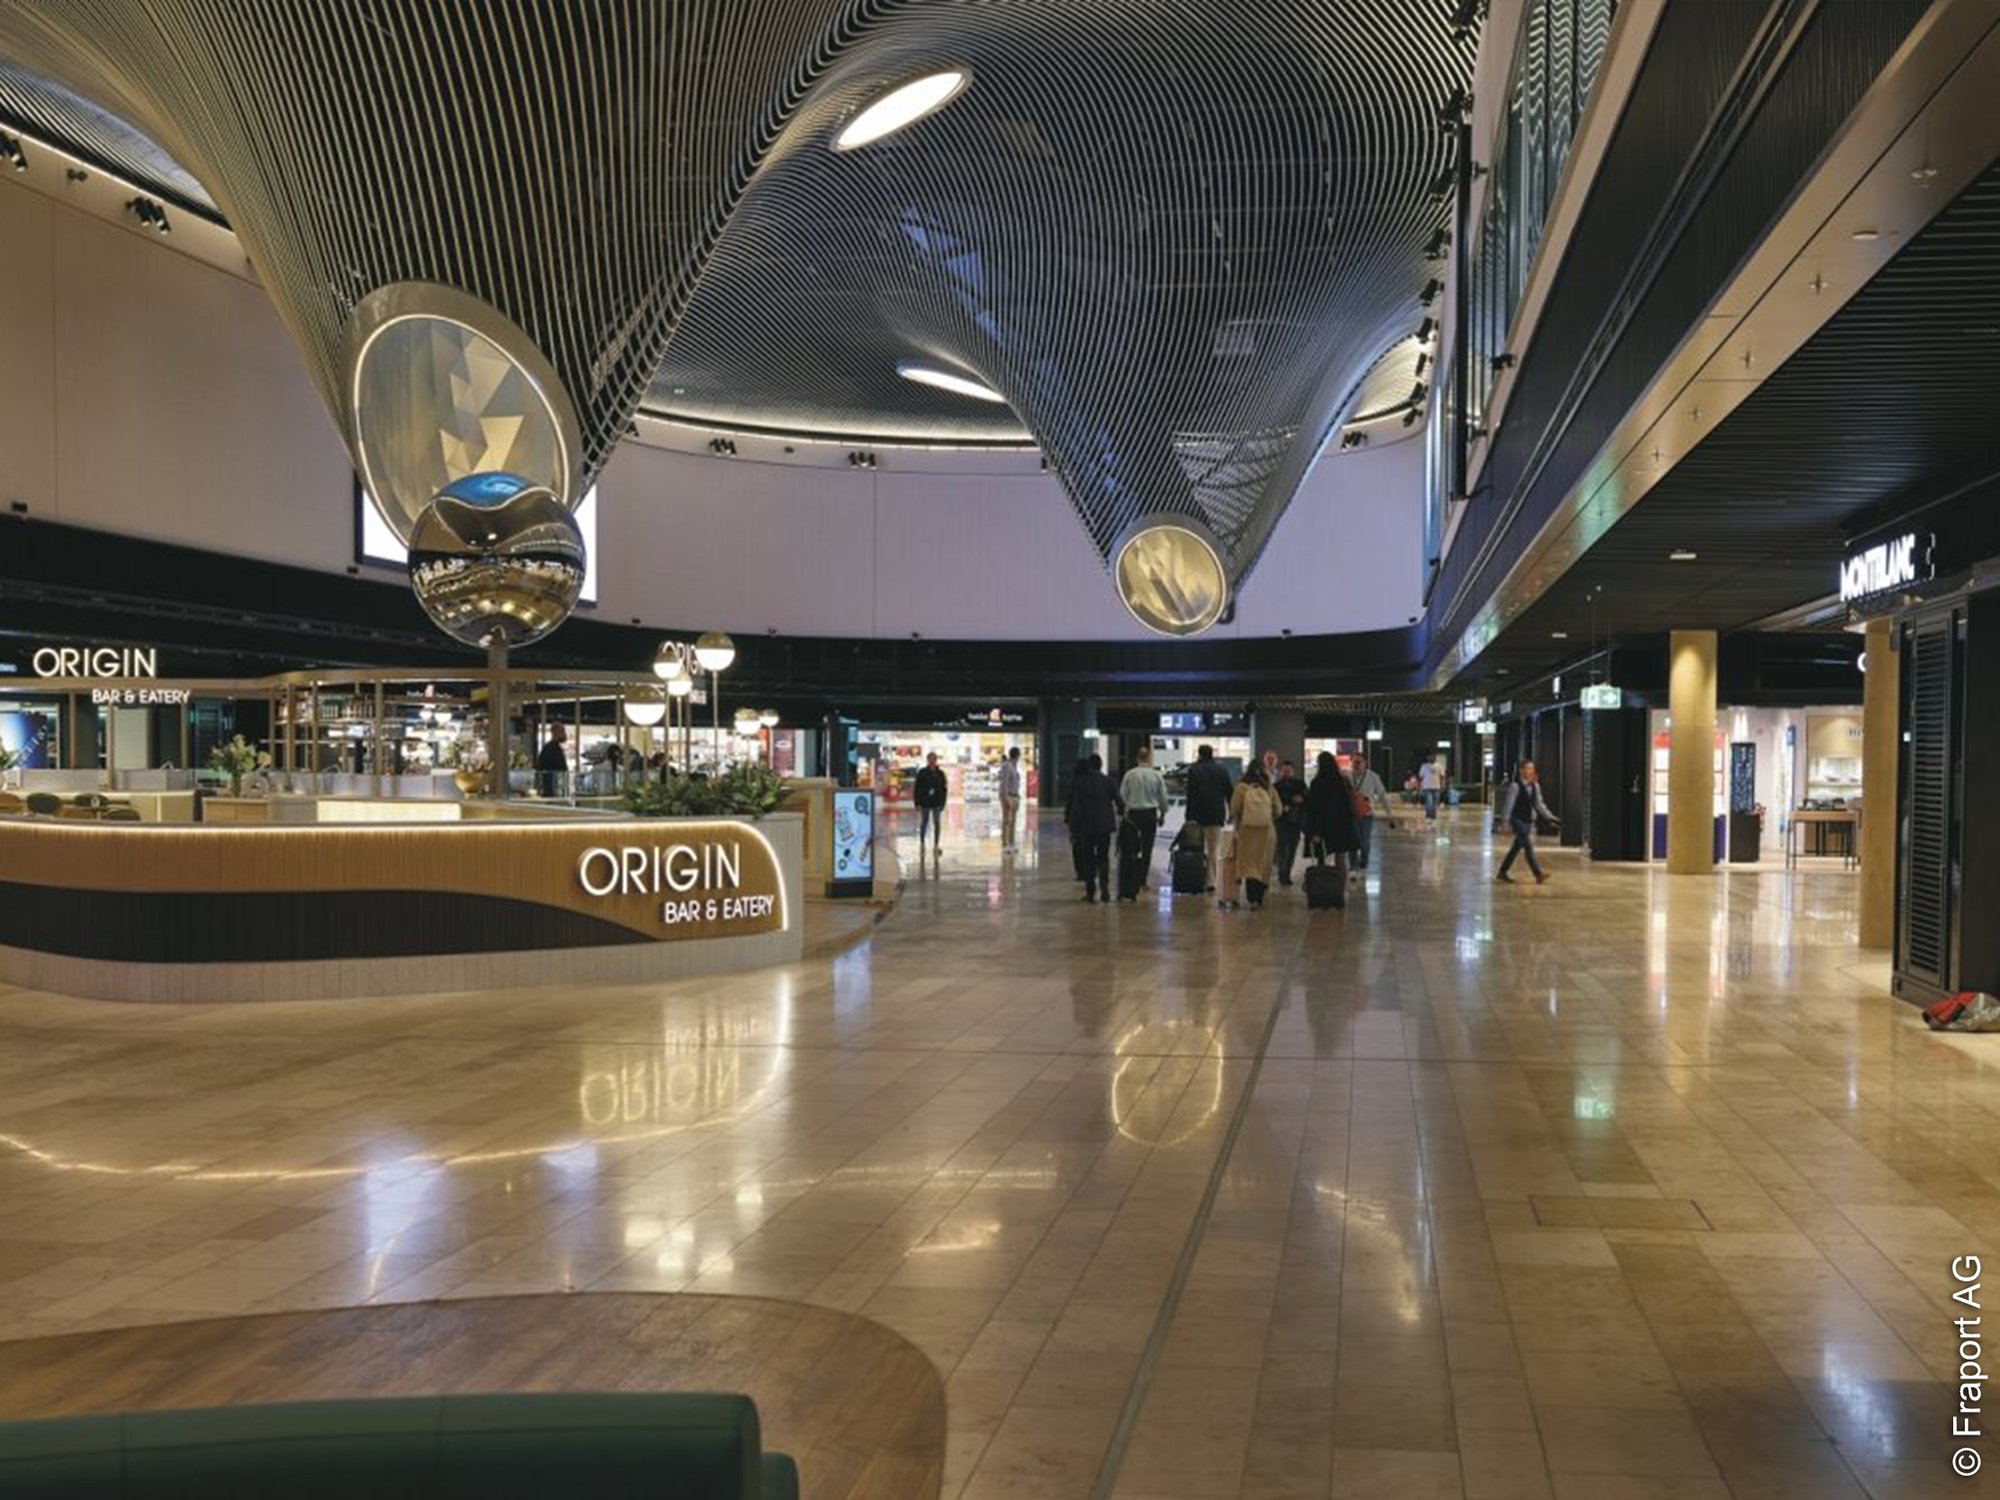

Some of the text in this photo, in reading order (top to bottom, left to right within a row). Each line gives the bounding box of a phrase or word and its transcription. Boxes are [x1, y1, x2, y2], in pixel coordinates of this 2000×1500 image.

[1840, 533, 1916, 602] MONTBLANC
[33, 647, 157, 677] ORIGIN
[92, 689, 191, 704] BAR & EATERY
[579, 842, 741, 896] ORIGIN
[663, 895, 775, 925] BAR & EATERY
